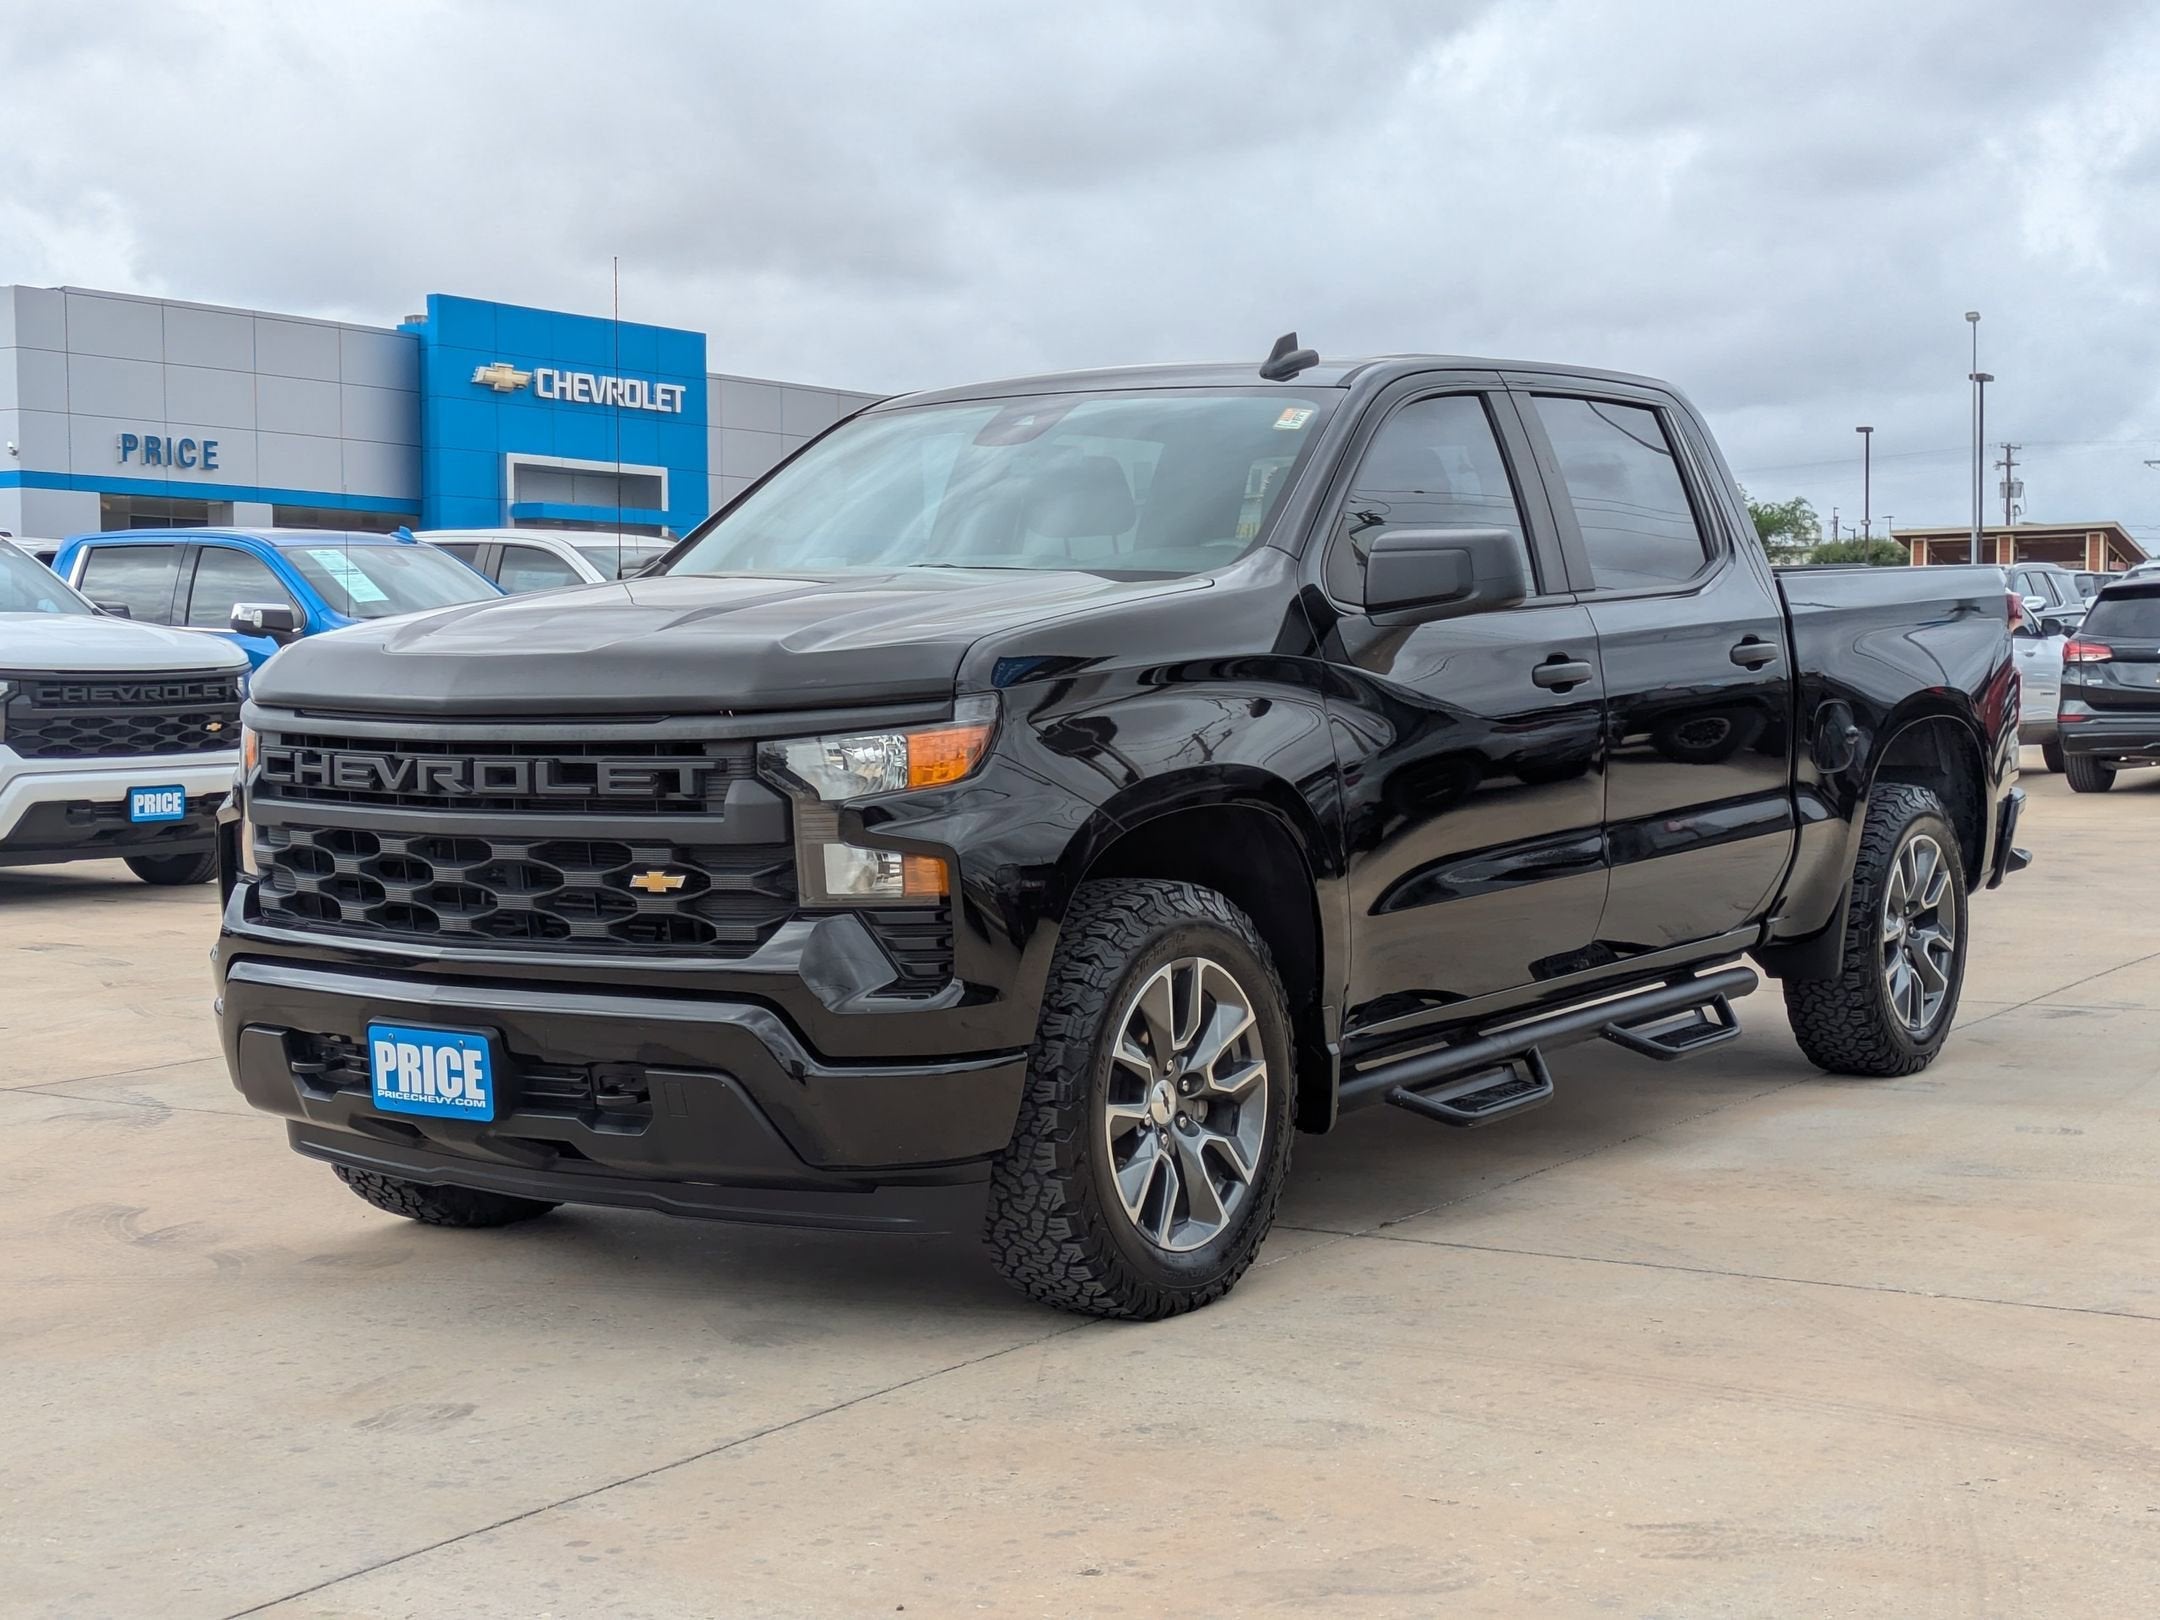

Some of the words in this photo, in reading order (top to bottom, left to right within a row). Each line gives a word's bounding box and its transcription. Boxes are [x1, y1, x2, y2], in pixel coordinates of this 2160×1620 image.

[534, 367, 686, 413] CHEVROLET
[118, 432, 220, 470] PRICE
[37, 683, 234, 703] CHEVROLET
[261, 747, 720, 796] CHEVROLET
[133, 792, 182, 815] PRICE
[374, 1040, 486, 1100] PRICE
[377, 1089, 486, 1108] PRICECHEVY.COM
